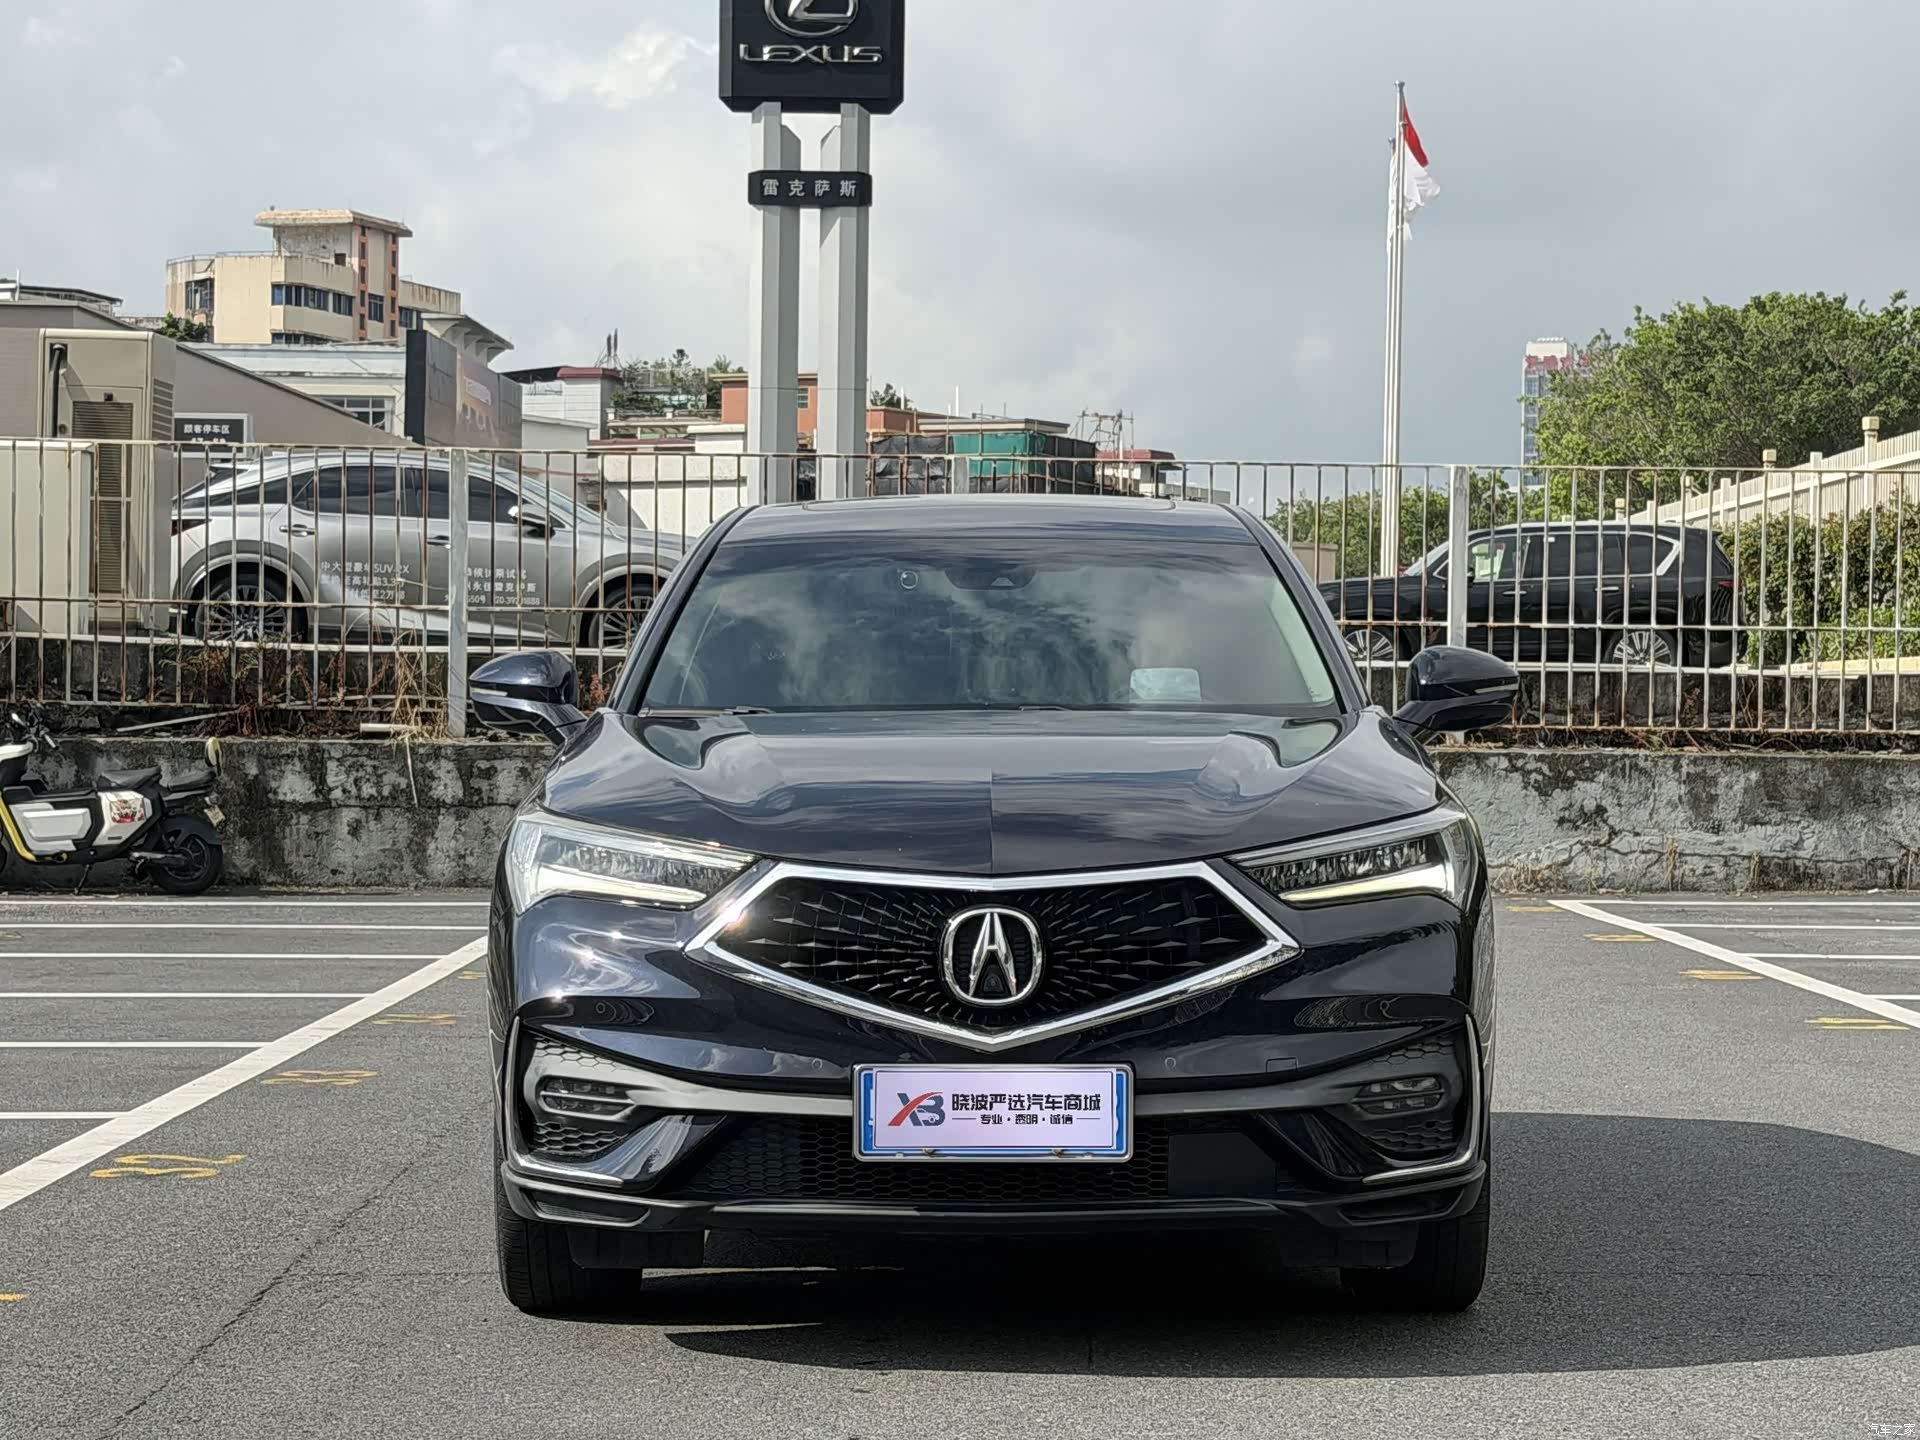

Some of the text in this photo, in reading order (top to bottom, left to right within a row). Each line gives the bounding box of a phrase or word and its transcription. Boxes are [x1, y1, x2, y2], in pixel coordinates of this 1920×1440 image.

[739, 44, 883, 63] LEXUS
[762, 178, 857, 197] 雷克萨斯
[951, 1093, 1101, 1111] 晓波严选汽车商城
